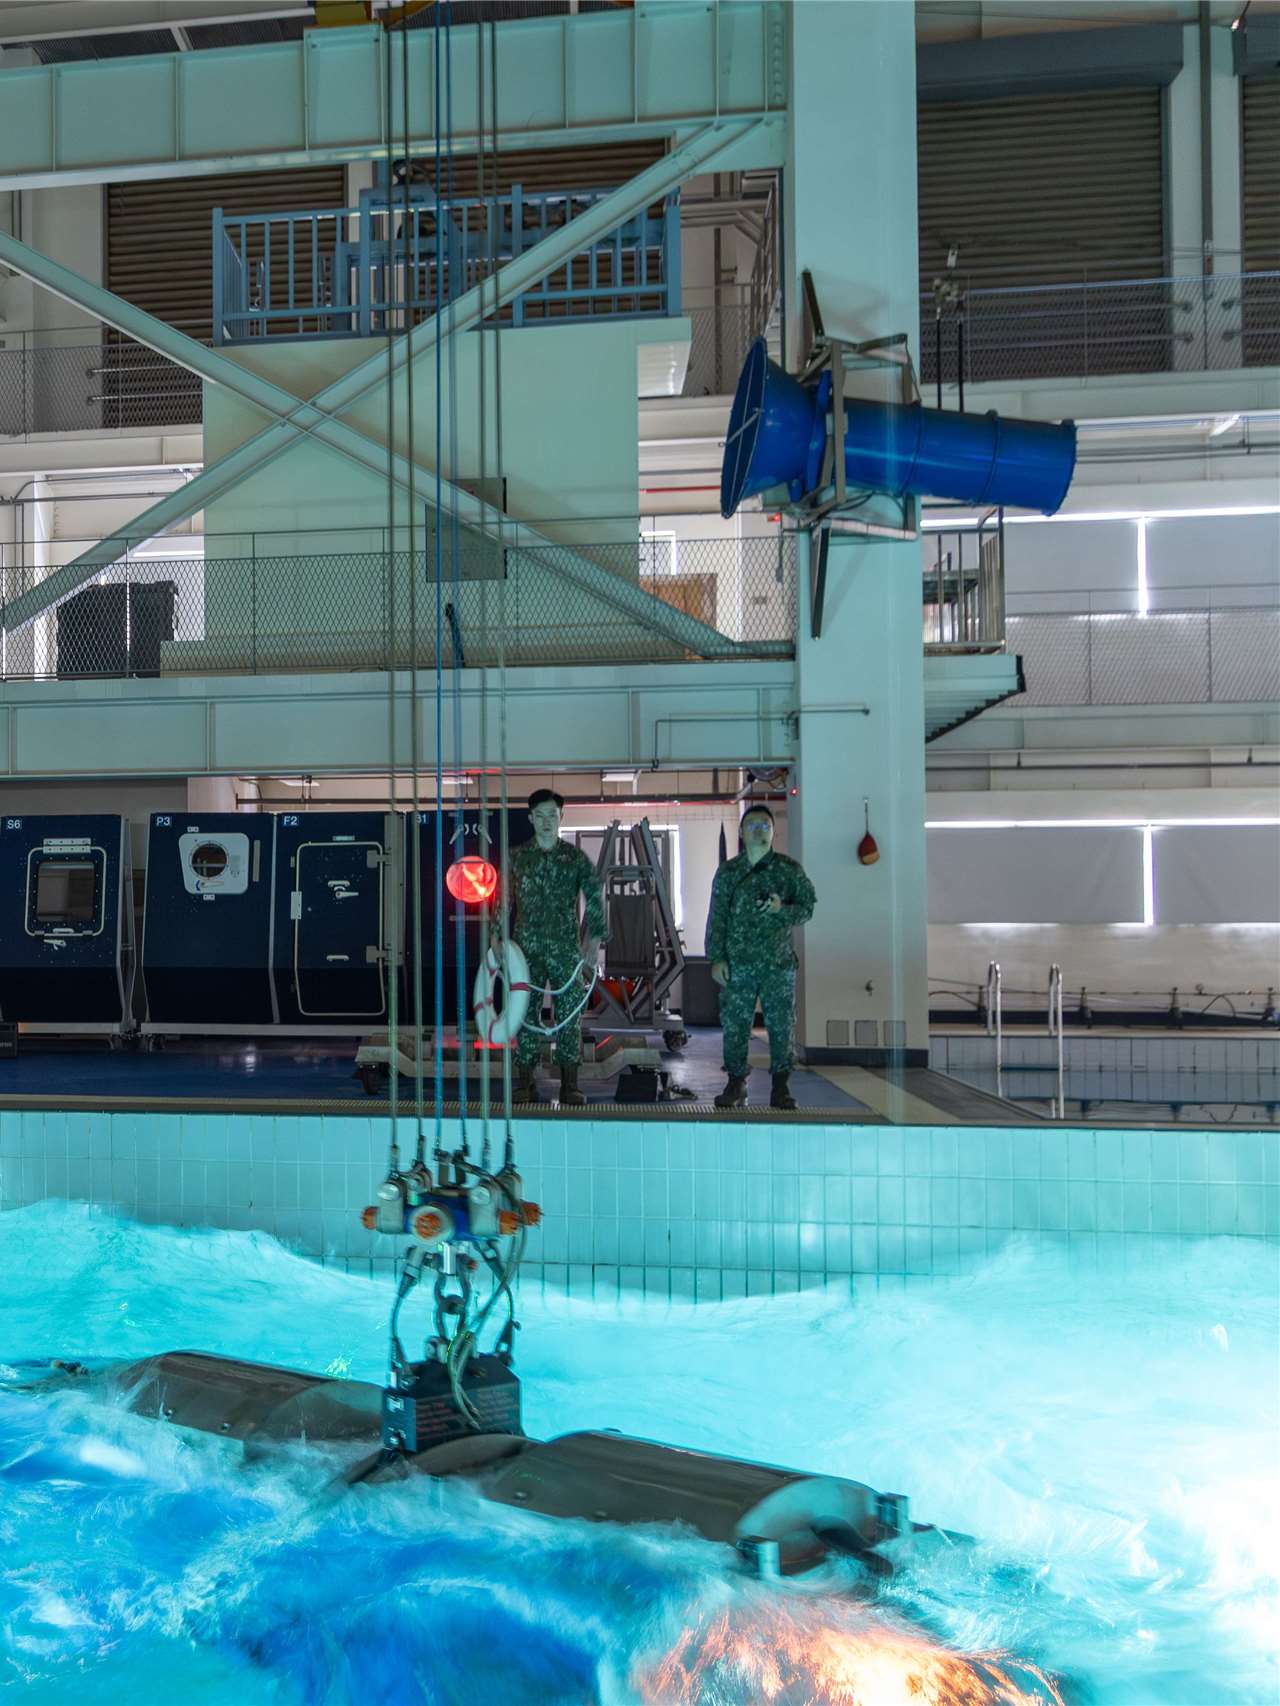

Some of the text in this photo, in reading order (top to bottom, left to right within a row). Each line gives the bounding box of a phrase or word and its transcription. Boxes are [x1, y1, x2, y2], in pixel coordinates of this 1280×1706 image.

[7, 819, 21, 829] S6
[156, 816, 171, 826] P3
[283, 816, 298, 826] F2
